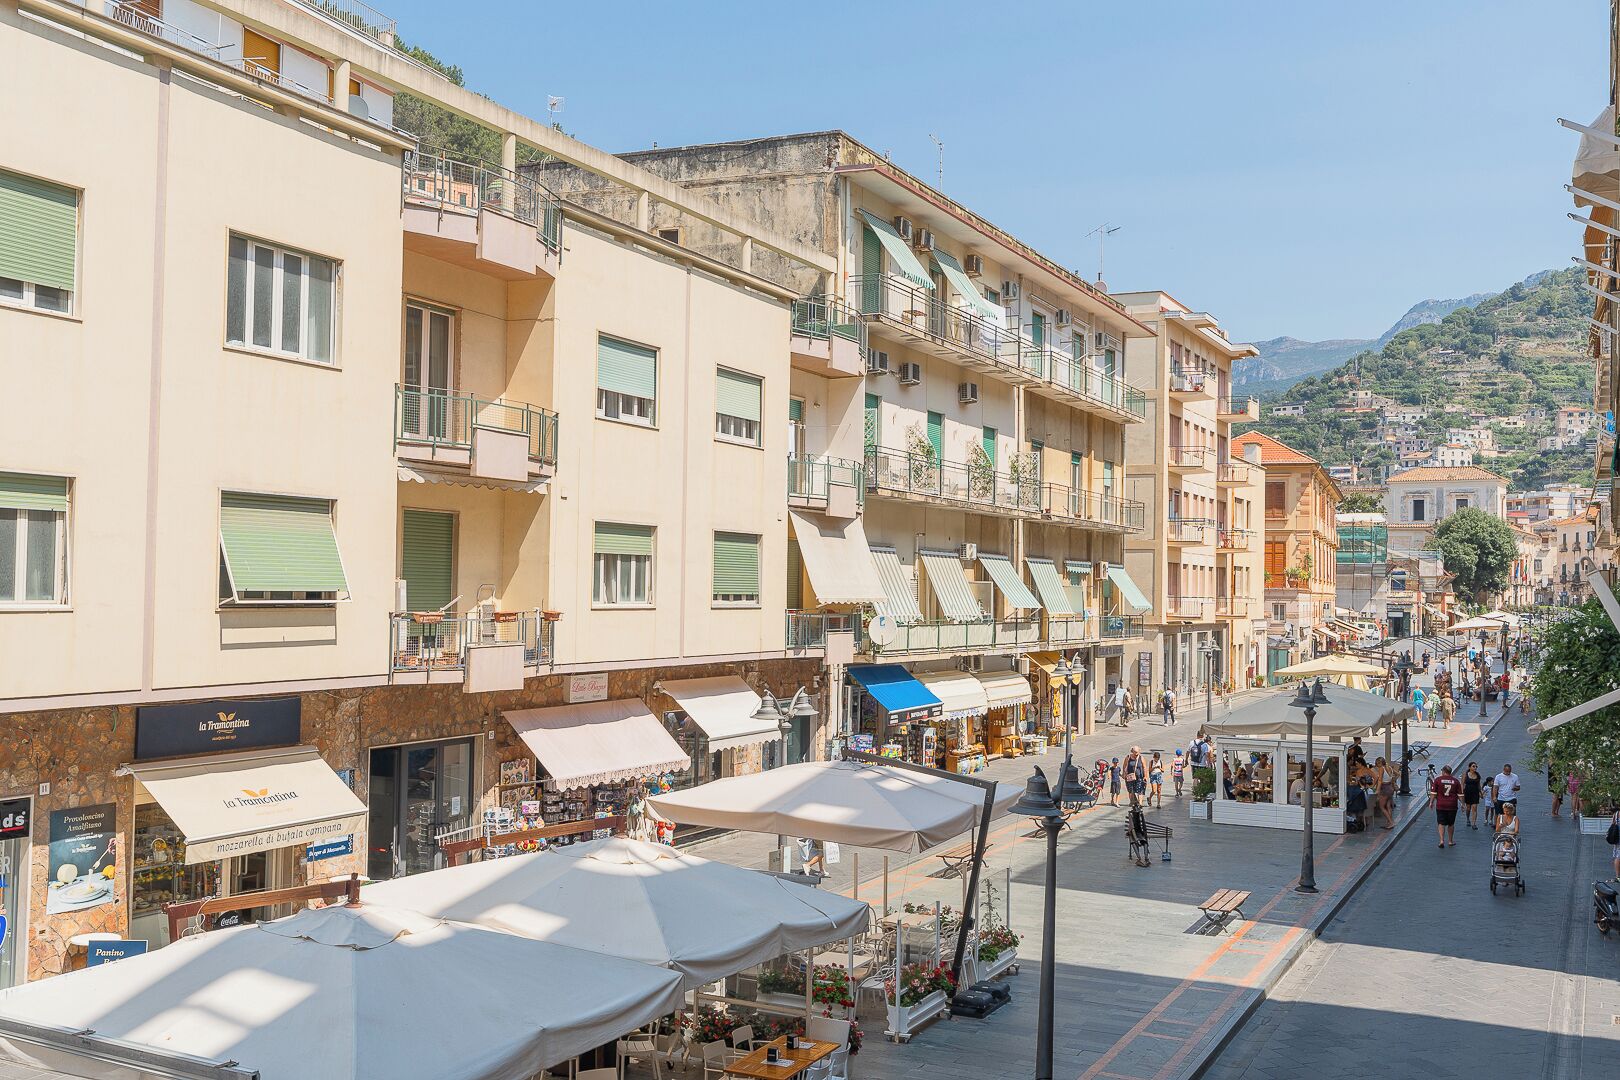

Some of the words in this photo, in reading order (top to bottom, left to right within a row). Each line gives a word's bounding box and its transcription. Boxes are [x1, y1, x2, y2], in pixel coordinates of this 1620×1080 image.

[199, 721, 207, 732] la
[207, 718, 250, 731] Tramontina
[1444, 784, 1452, 796] 7
[223, 800, 236, 809] la
[236, 791, 298, 807] Tramontina
[63, 812, 105, 824] Provoloncino
[66, 821, 102, 832] Amalfitano
[217, 837, 263, 853] mozzarella
[266, 834, 274, 844] di
[277, 830, 303, 842] bufala
[305, 822, 342, 837] campana
[95, 948, 124, 957] Panino
